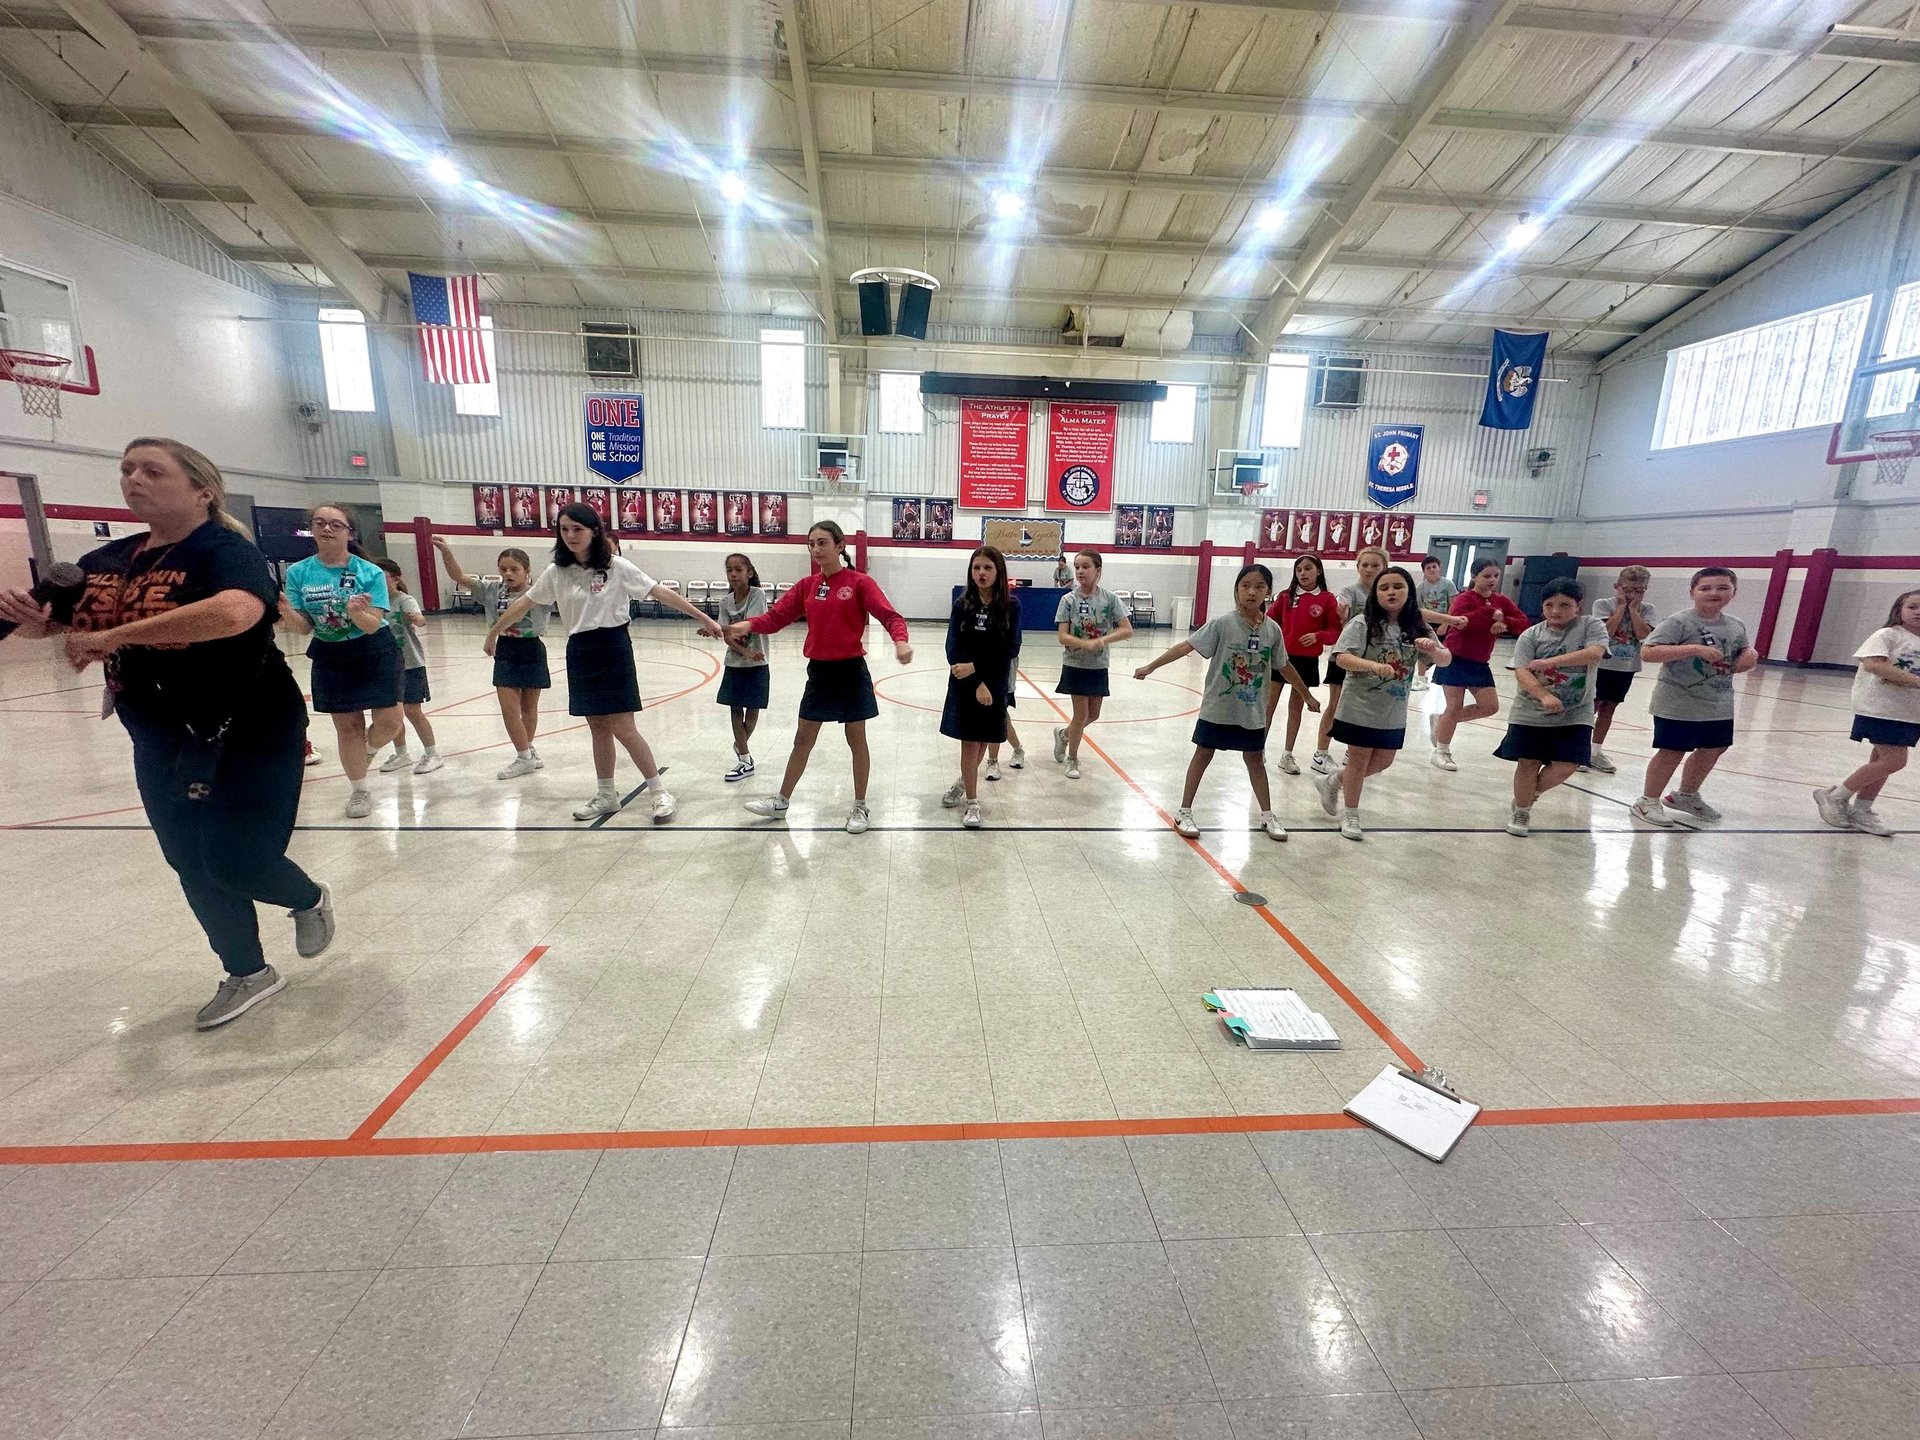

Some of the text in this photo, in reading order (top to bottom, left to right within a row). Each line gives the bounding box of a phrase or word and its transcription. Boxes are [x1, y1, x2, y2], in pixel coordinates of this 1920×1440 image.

[588, 398, 640, 428] ONE
[591, 432, 640, 442] ONE Tradition
[592, 442, 640, 451] ONE Mission
[592, 452, 640, 462] ONE School
